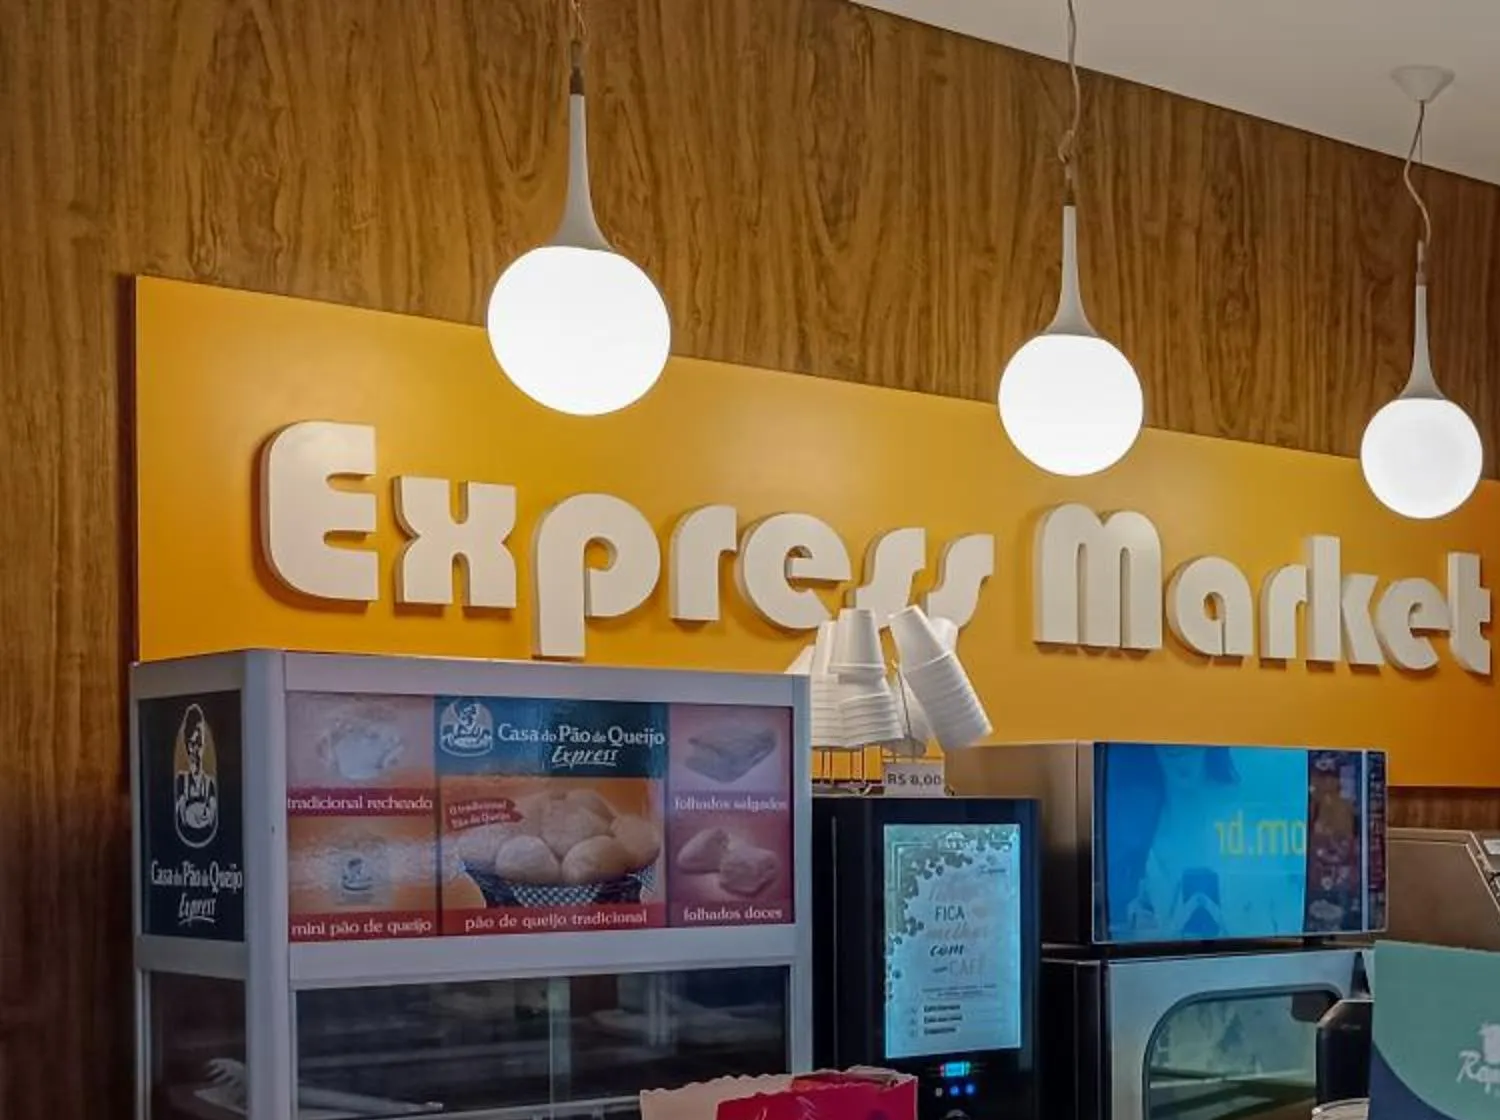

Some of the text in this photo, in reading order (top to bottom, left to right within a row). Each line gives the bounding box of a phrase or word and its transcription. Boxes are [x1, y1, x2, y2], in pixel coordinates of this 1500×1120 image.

[257, 421, 1491, 676] Express Market
[498, 722, 665, 748] Casa do Pão de Queijo
[551, 746, 618, 770] Express
[287, 796, 433, 811] tradicional recheado
[151, 860, 174, 886] Casa
[182, 860, 200, 888] Pão
[209, 861, 242, 894] Queijo
[464, 910, 647, 933] pão de queijo tradicional
[683, 904, 783, 922] folhados doces
[935, 905, 965, 921] FICA
[291, 917, 432, 942] mini pão de queijo
